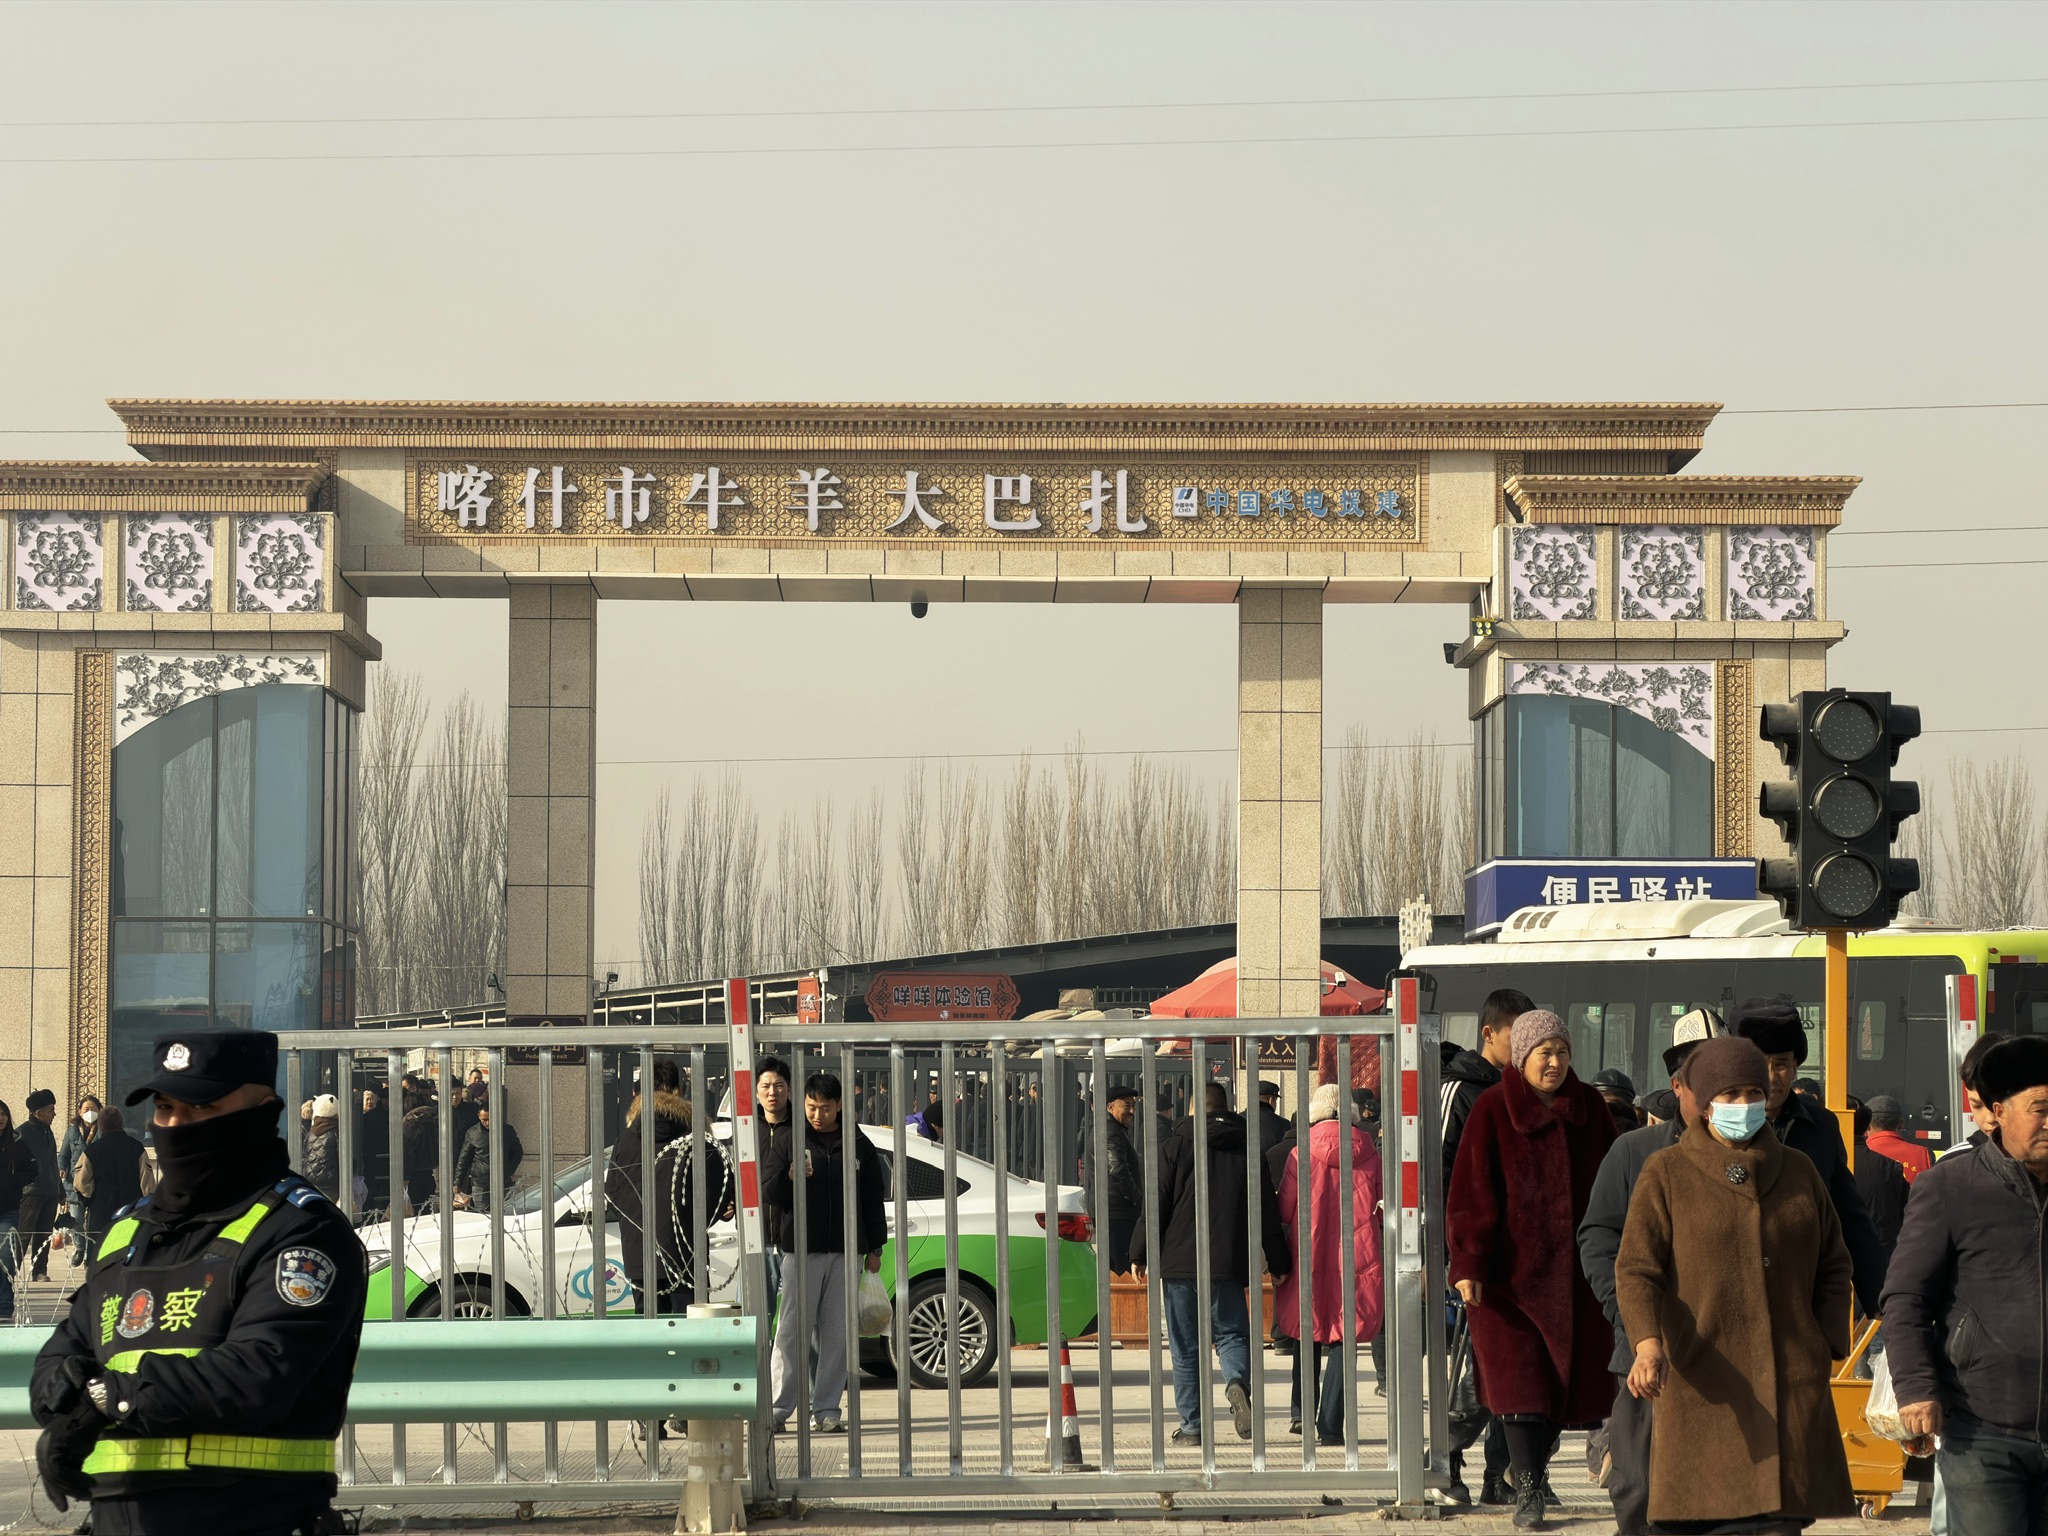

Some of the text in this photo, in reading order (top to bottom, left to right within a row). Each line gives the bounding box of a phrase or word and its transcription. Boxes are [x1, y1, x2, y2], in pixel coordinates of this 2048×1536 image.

[437, 464, 1148, 533] 喀什市牛羊大巴扎
[1206, 487, 1401, 518] 中国华电援建
[1540, 875, 1713, 905] 便民驿站
[893, 985, 991, 1008] 咩咩体验馆
[100, 1287, 202, 1346] 警察
